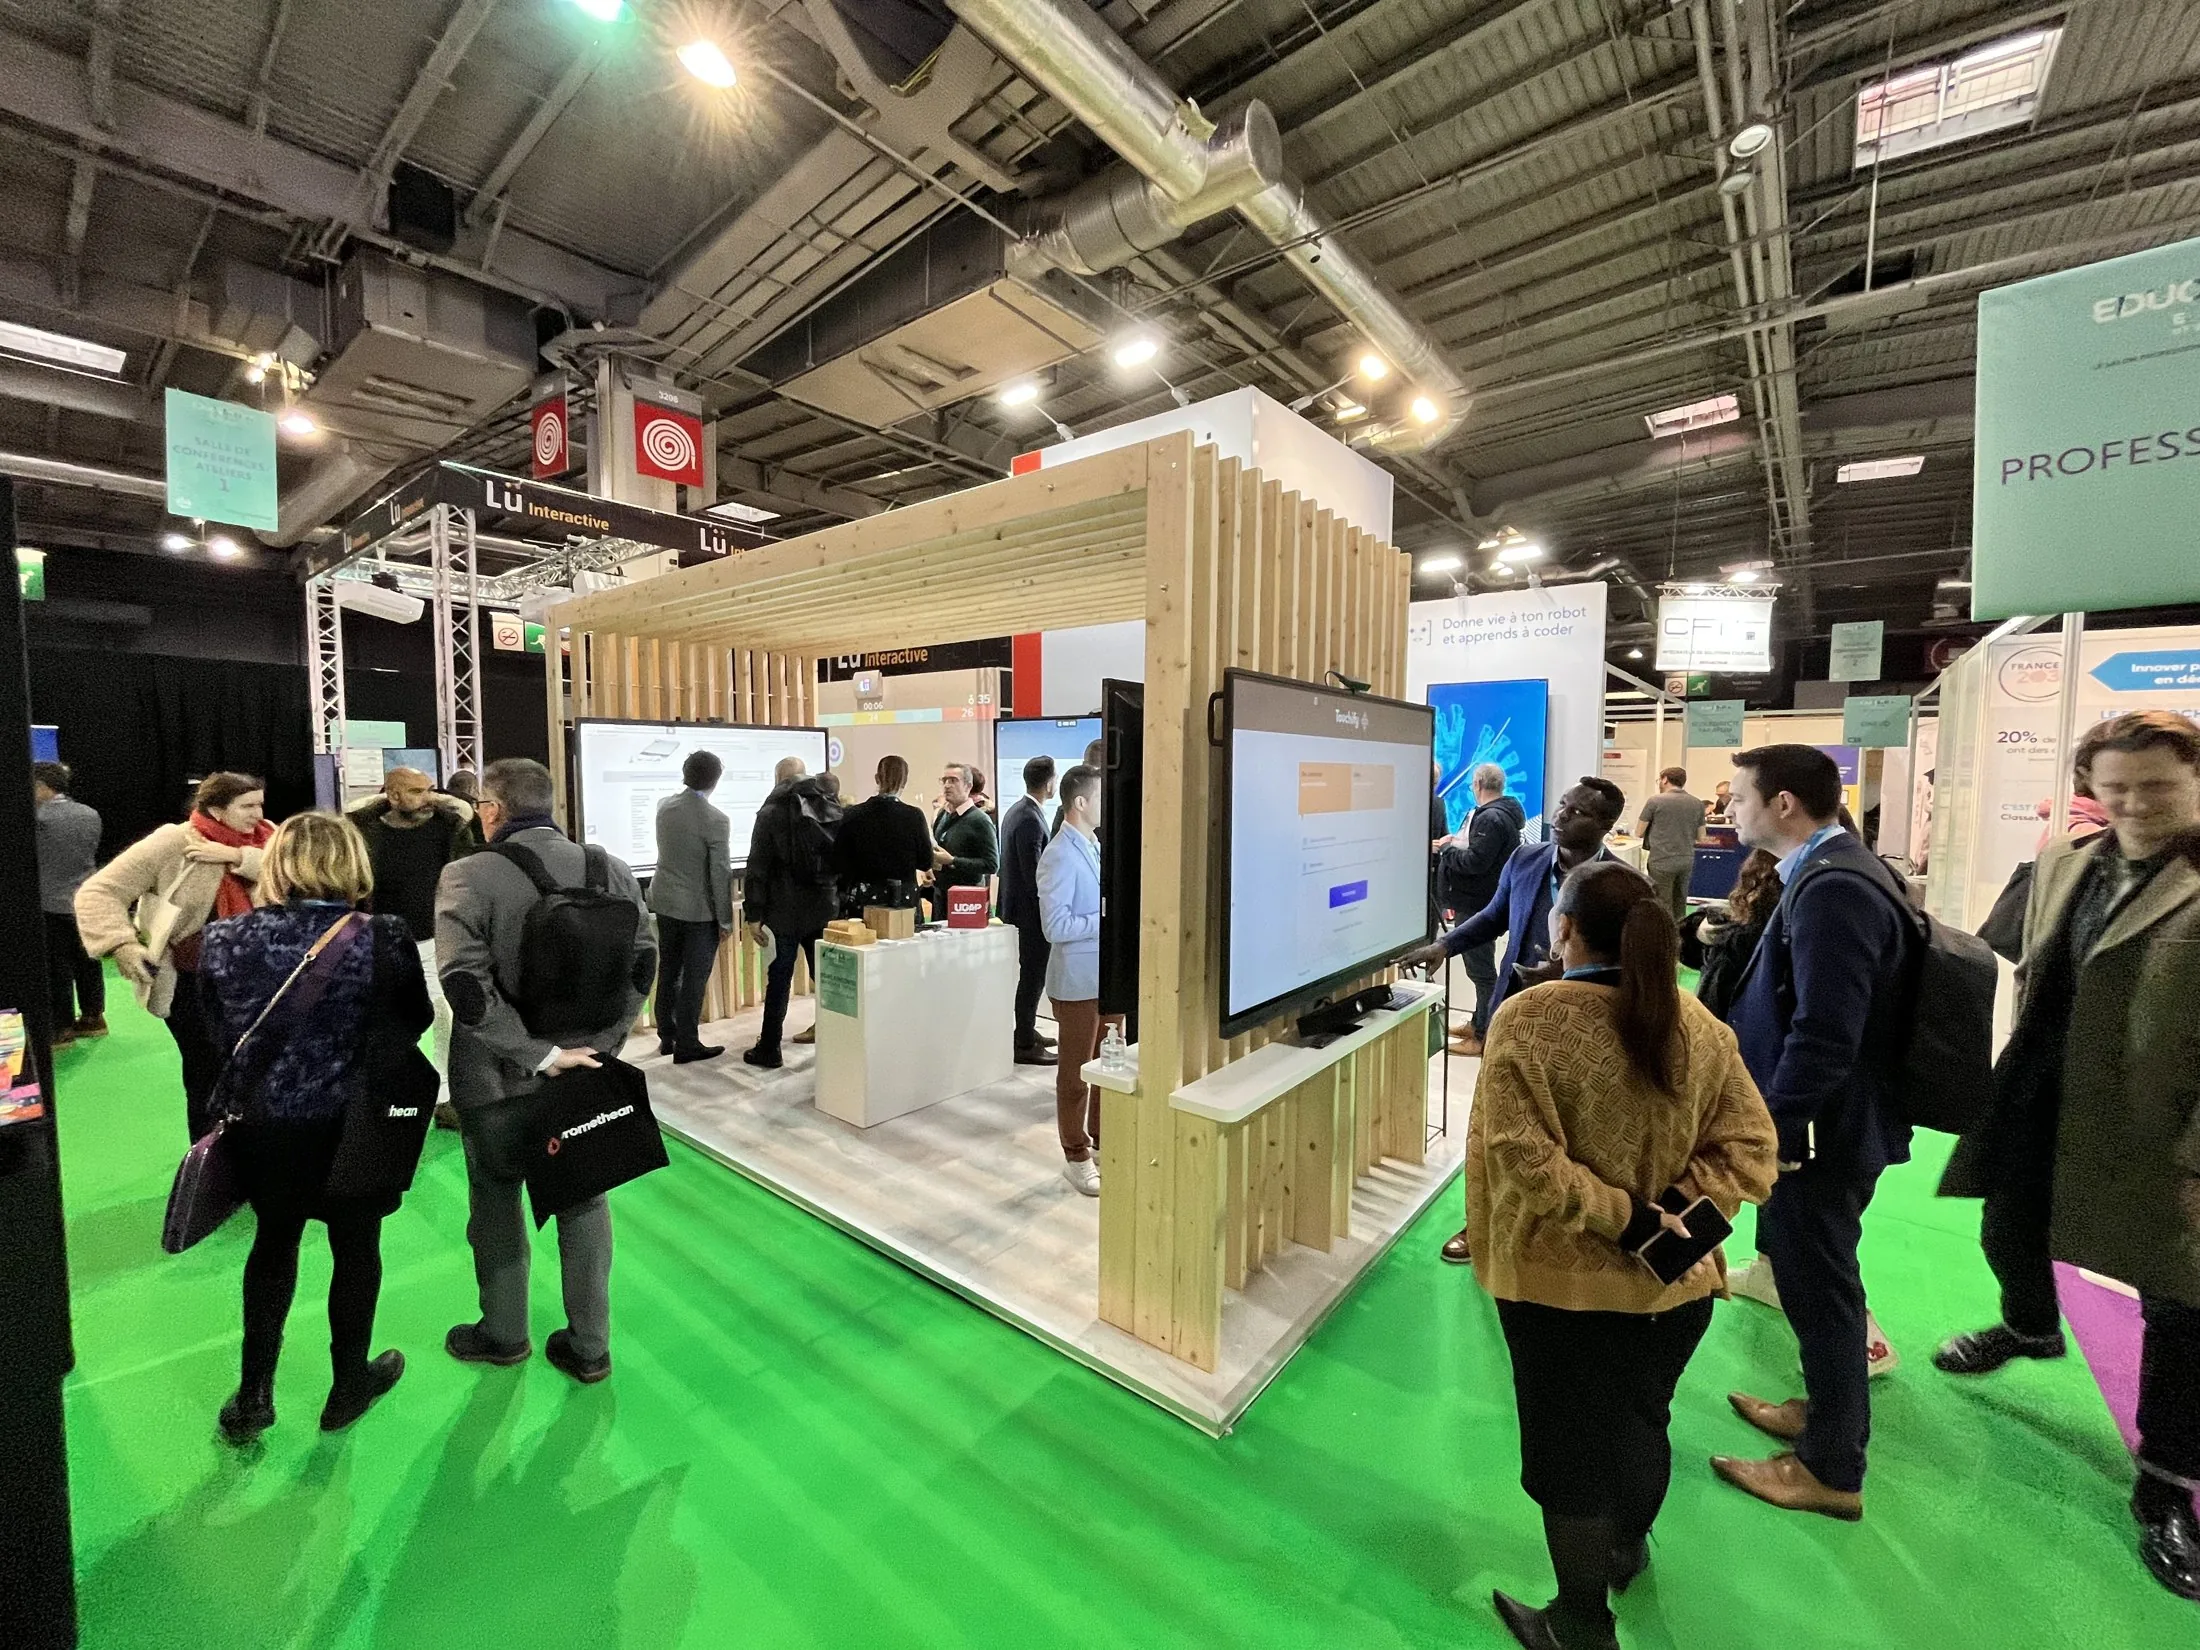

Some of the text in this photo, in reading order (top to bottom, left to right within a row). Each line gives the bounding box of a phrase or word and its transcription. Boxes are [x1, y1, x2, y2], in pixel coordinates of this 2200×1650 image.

[528, 503, 610, 532] Interactive
[700, 527, 727, 555] Lü
[1442, 606, 1588, 630] Donne vie à ton robot
[1442, 624, 1574, 646] et apprends à coder
[864, 648, 929, 668] Interactive
[2010, 661, 2060, 671] FRANCE
[2131, 663, 2188, 673] Innover
[2153, 676, 2174, 684] en
[977, 693, 991, 704] 35
[863, 701, 884, 711] 00:06
[961, 708, 975, 718] 26
[1996, 730, 2038, 744] 20%
[1999, 813, 2040, 822] Classes
[560, 1104, 635, 1139] romethean
